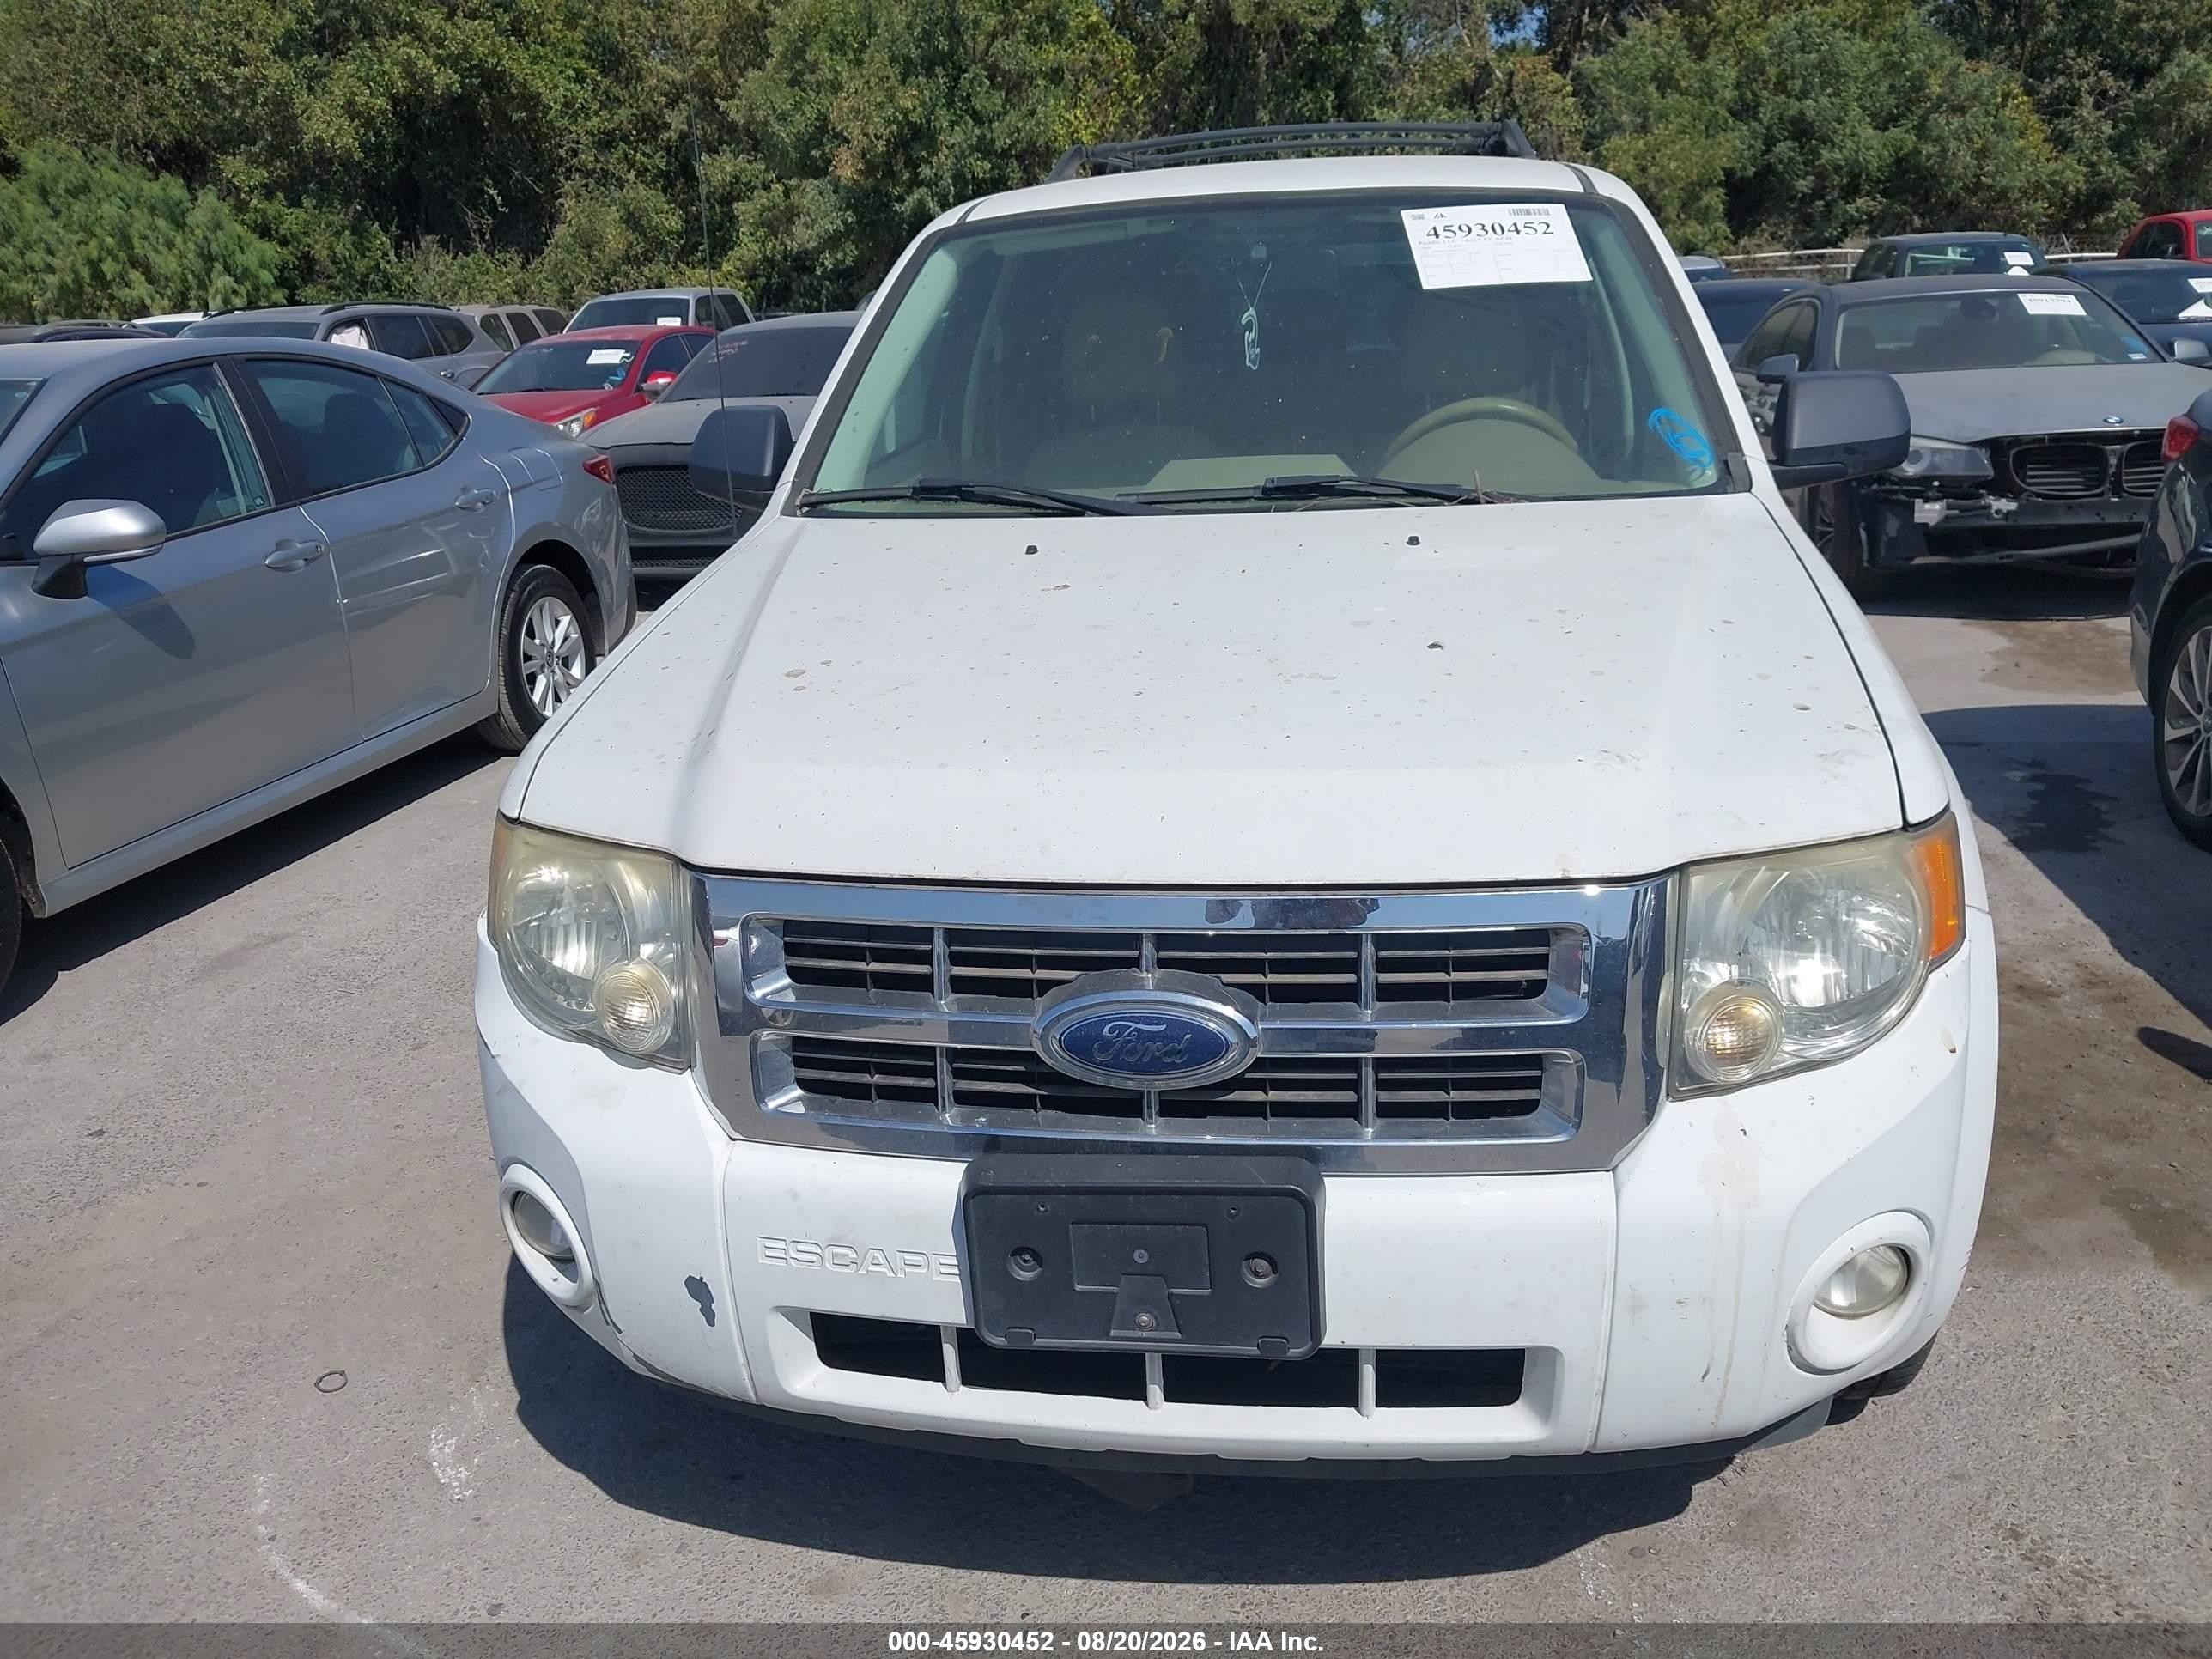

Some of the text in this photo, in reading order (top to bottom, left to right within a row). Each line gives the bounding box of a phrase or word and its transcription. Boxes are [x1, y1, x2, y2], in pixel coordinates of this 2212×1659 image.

[1425, 221, 1555, 240] 45930452
[1092, 1020, 1193, 1064] Ford
[755, 1235, 962, 1283] ESCAPE
